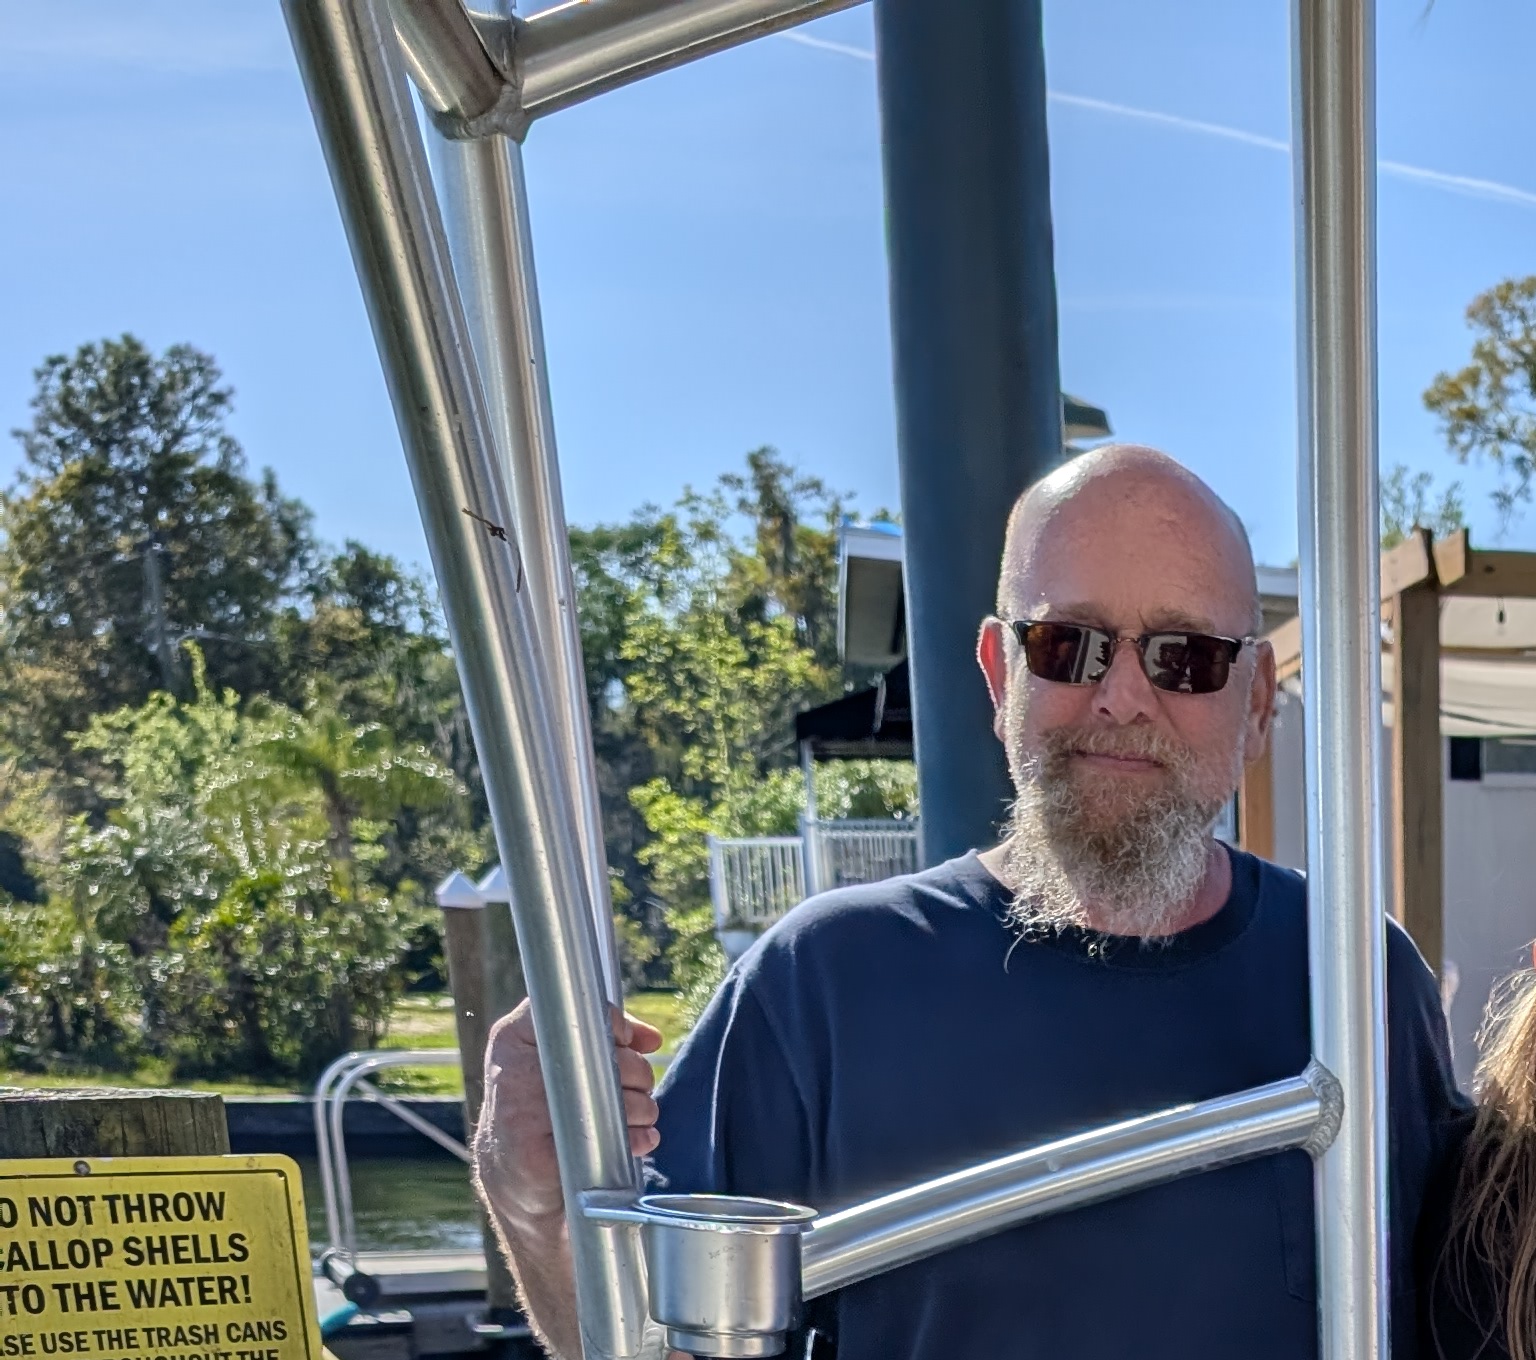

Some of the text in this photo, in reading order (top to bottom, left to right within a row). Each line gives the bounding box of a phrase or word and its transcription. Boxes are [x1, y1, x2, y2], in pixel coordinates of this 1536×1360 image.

[29, 1195, 96, 1228] NOT
[102, 1191, 226, 1225] THROW
[123, 1233, 250, 1266] SHELLS
[52, 1281, 121, 1313] THE
[125, 1274, 252, 1309] WATER!
[0, 1320, 288, 1356] SE USE THE TRASH CANS
